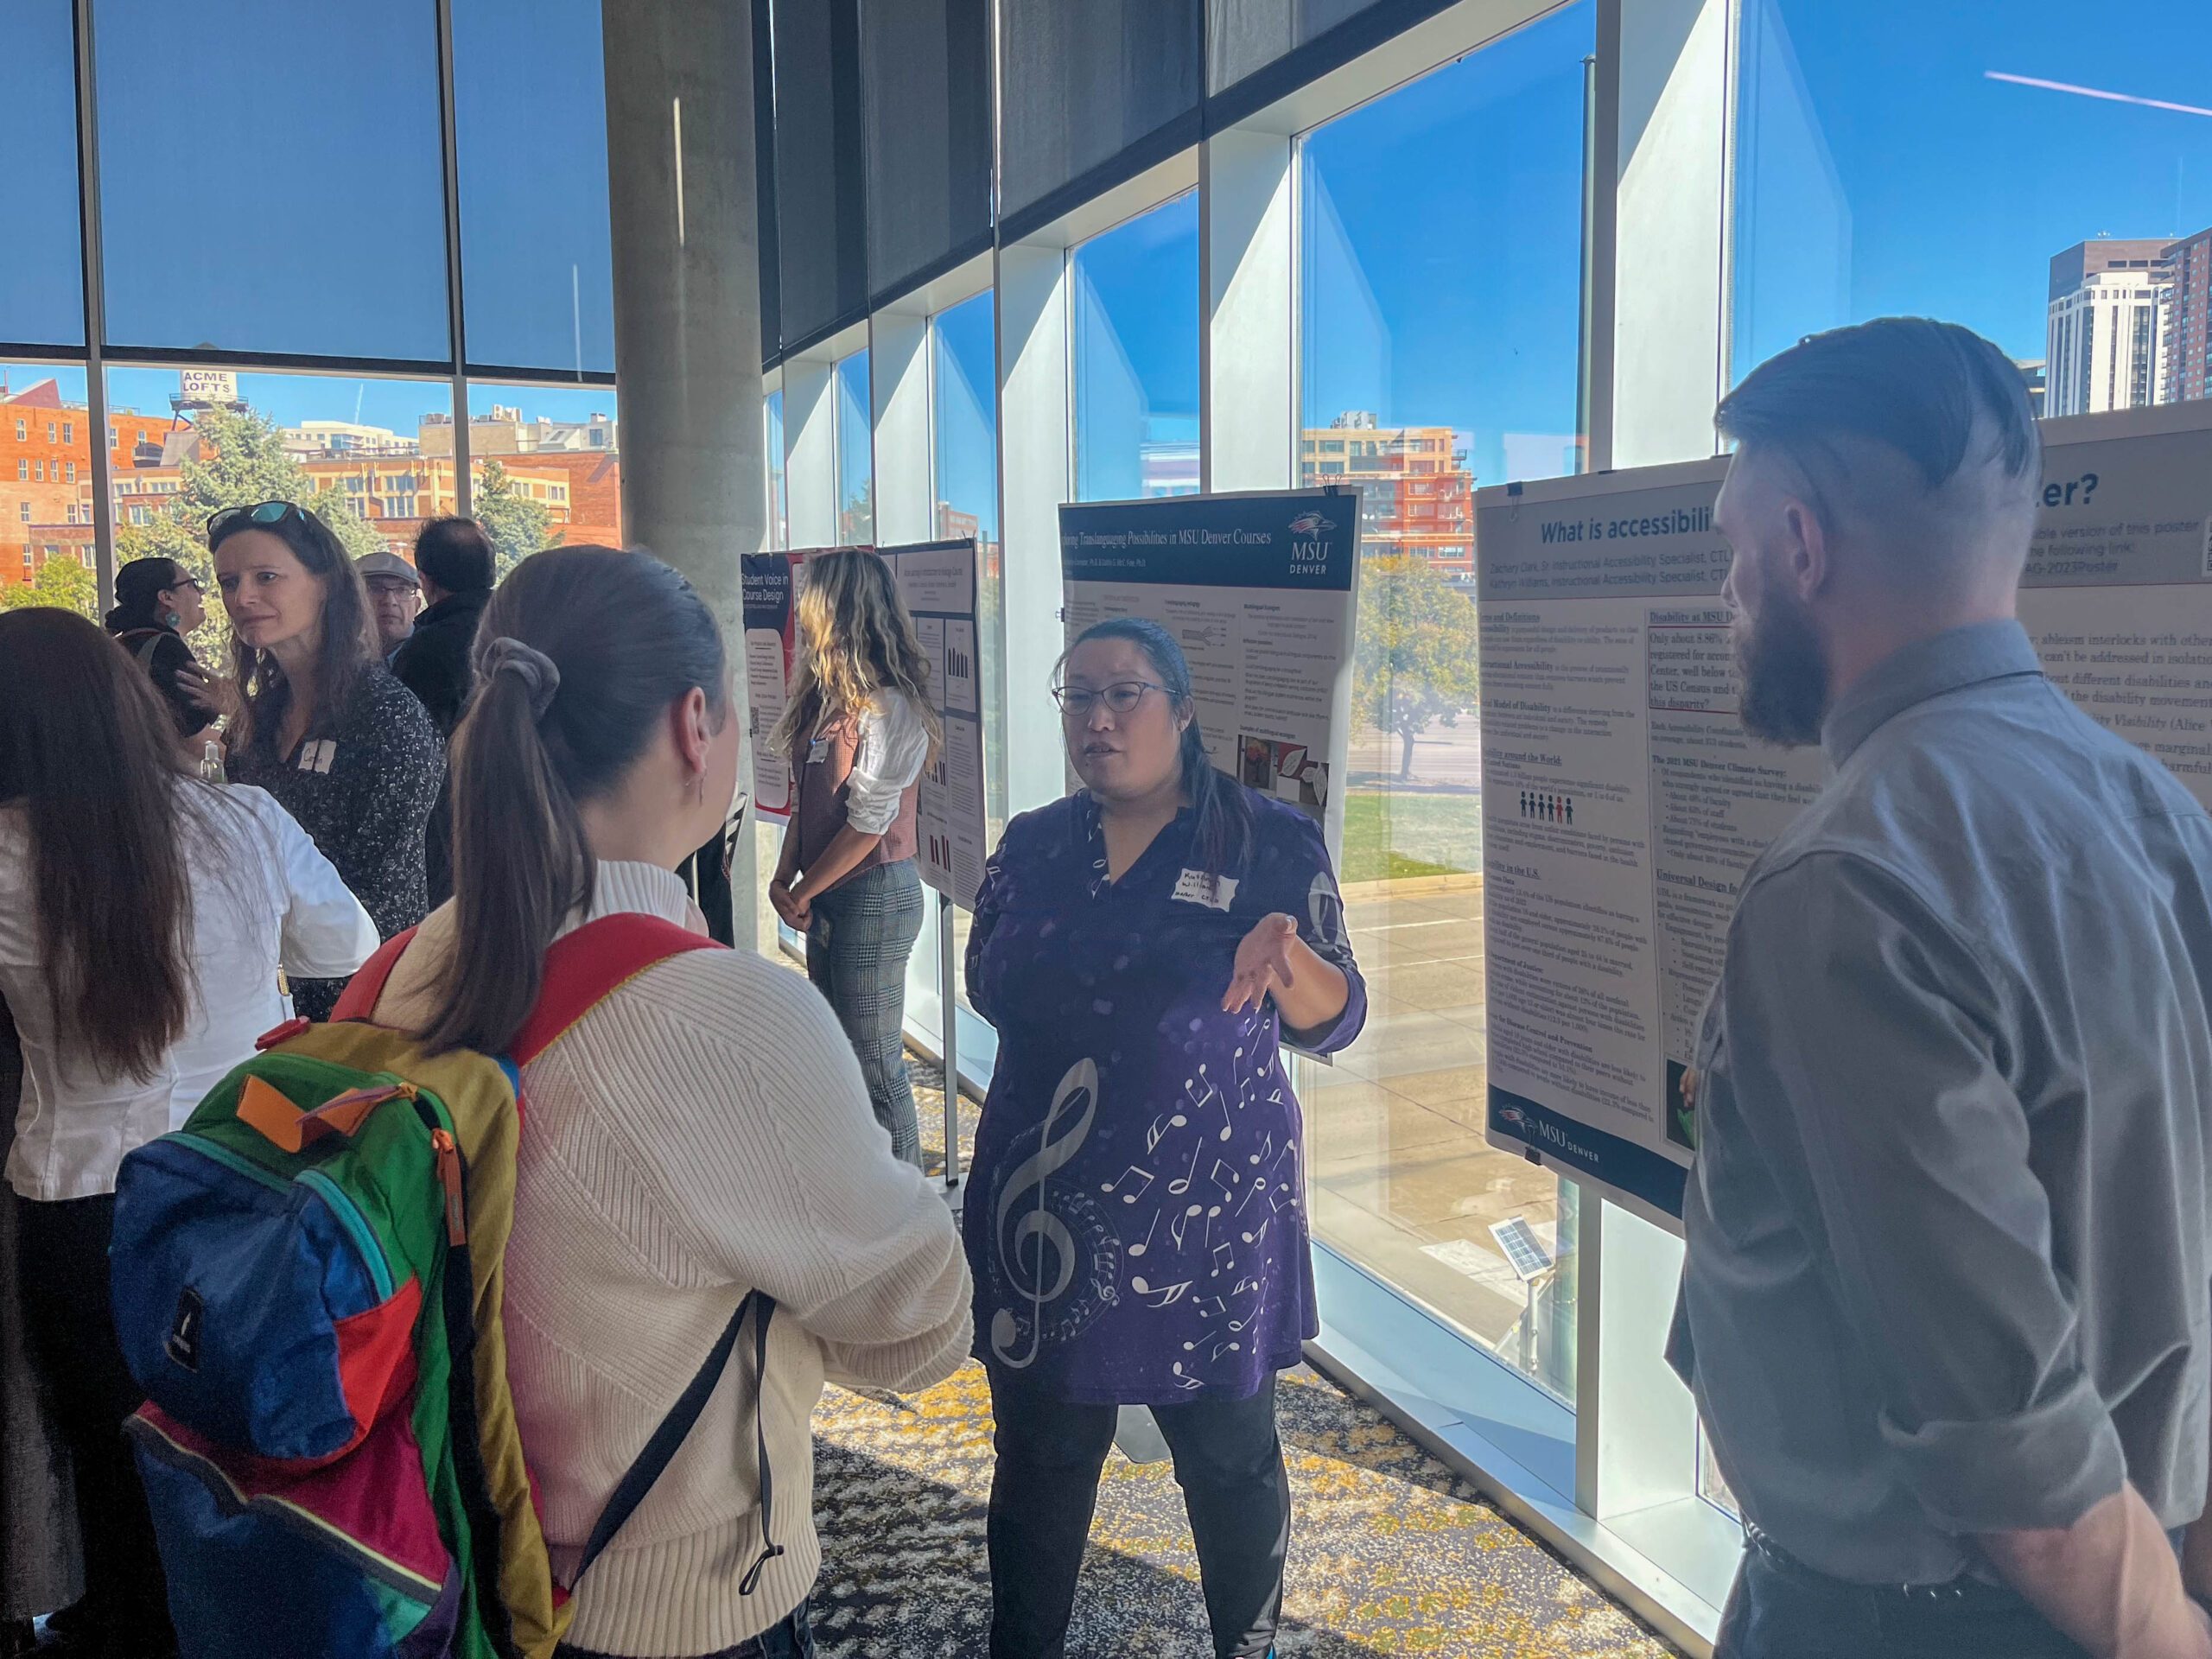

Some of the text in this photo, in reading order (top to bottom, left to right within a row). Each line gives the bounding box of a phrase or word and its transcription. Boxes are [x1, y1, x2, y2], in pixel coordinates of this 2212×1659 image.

[184, 372, 227, 382] ACME
[183, 383, 230, 393] LOFTS
[1541, 520, 1583, 543] What
[1589, 518, 1602, 539] is
[2037, 473, 2100, 507] er?
[2061, 526, 2106, 538] version
[2109, 524, 2125, 536] of
[2155, 521, 2199, 536] poster
[1079, 528, 1272, 550] Translanguaging Possibilities in MSU Denver Courses
[1291, 542, 1329, 561] MSU
[2048, 543, 2105, 556] following
[1554, 558, 1600, 570] Instructional
[1603, 554, 1656, 568] Accessibility
[1289, 564, 1326, 575] DENVER
[742, 573, 789, 586] Student Voice in
[1552, 575, 1600, 588] Instructional
[1602, 571, 1656, 586] Accessibility
[743, 588, 784, 604] Course Design
[1505, 612, 1541, 623] Definitions
[1650, 611, 1689, 624] Disability
[1702, 611, 1725, 623] MSU
[1649, 632, 1669, 646] Only
[1670, 632, 1695, 644] about
[2041, 634, 2084, 645] ableism
[2088, 633, 2146, 647] interlocks
[2149, 634, 2177, 647] with
[1649, 649, 1690, 662] registered
[1691, 649, 1706, 661] for
[2044, 650, 2212, 666] can't be addressed in isolatio
[1513, 660, 1554, 672] Accessibility
[1681, 664, 1700, 677] well
[1700, 664, 1726, 677] below
[1650, 680, 1729, 695] the US Census and
[2072, 671, 2121, 687] different
[2124, 672, 2190, 690] disabilities
[1520, 700, 1551, 714] Disability
[1650, 696, 1711, 710] this disparity?
[2070, 691, 2212, 709] the disability movement
[2114, 714, 2206, 732] Visibility (Alice
[1503, 752, 1527, 762] around
[1528, 753, 1540, 763] the
[1651, 754, 1666, 765] The
[1682, 758, 1700, 768] MSU
[1700, 759, 1726, 772] Denver
[1726, 761, 1756, 774] Climate
[1756, 765, 1786, 779] Survey:
[1763, 778, 1788, 792] having
[1731, 787, 1753, 798] agreed
[1770, 791, 1787, 804] they
[1787, 793, 1801, 804] feel
[1514, 864, 1526, 875] the
[1656, 868, 1696, 887] Universal
[1698, 874, 1727, 895] Design
[1526, 1024, 1547, 1039] Control
[1547, 1033, 1560, 1043] and
[1559, 1034, 1592, 1053] Prevention
[1539, 1120, 1600, 1163] MSU DENVER
